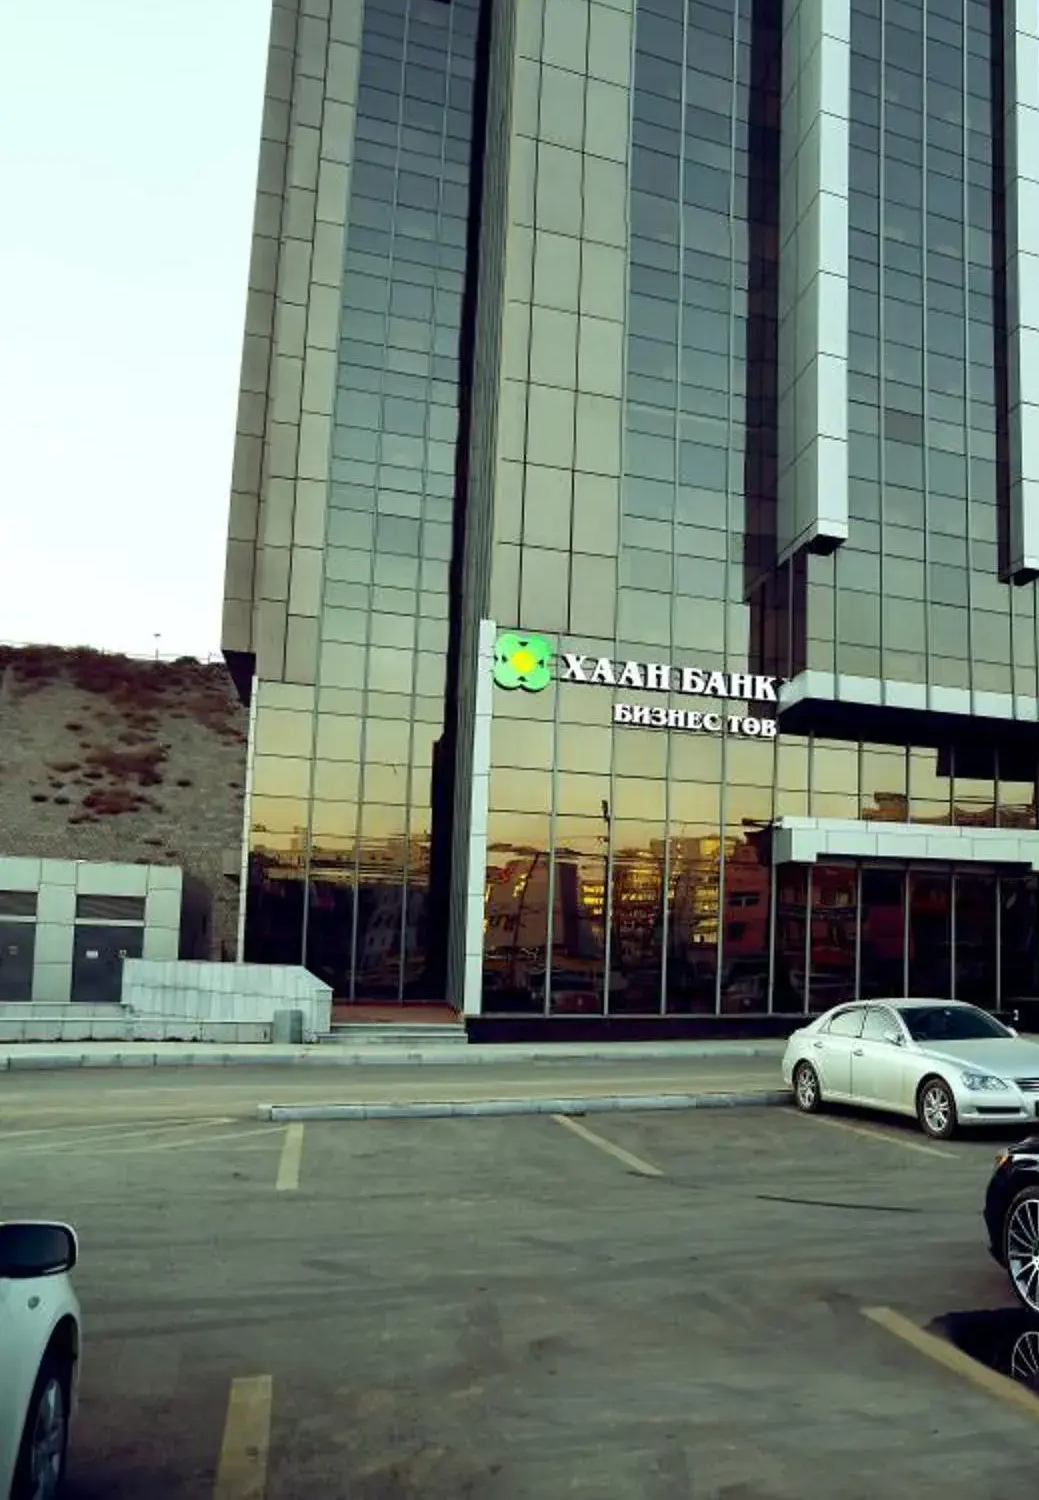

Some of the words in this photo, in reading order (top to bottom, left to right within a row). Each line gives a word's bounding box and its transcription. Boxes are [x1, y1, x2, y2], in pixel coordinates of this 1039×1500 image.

[562, 652, 671, 690] ХААН
[681, 666, 778, 702] БАНК
[612, 703, 721, 732] БИЗНЕС
[726, 715, 778, 738] ТӨВ
